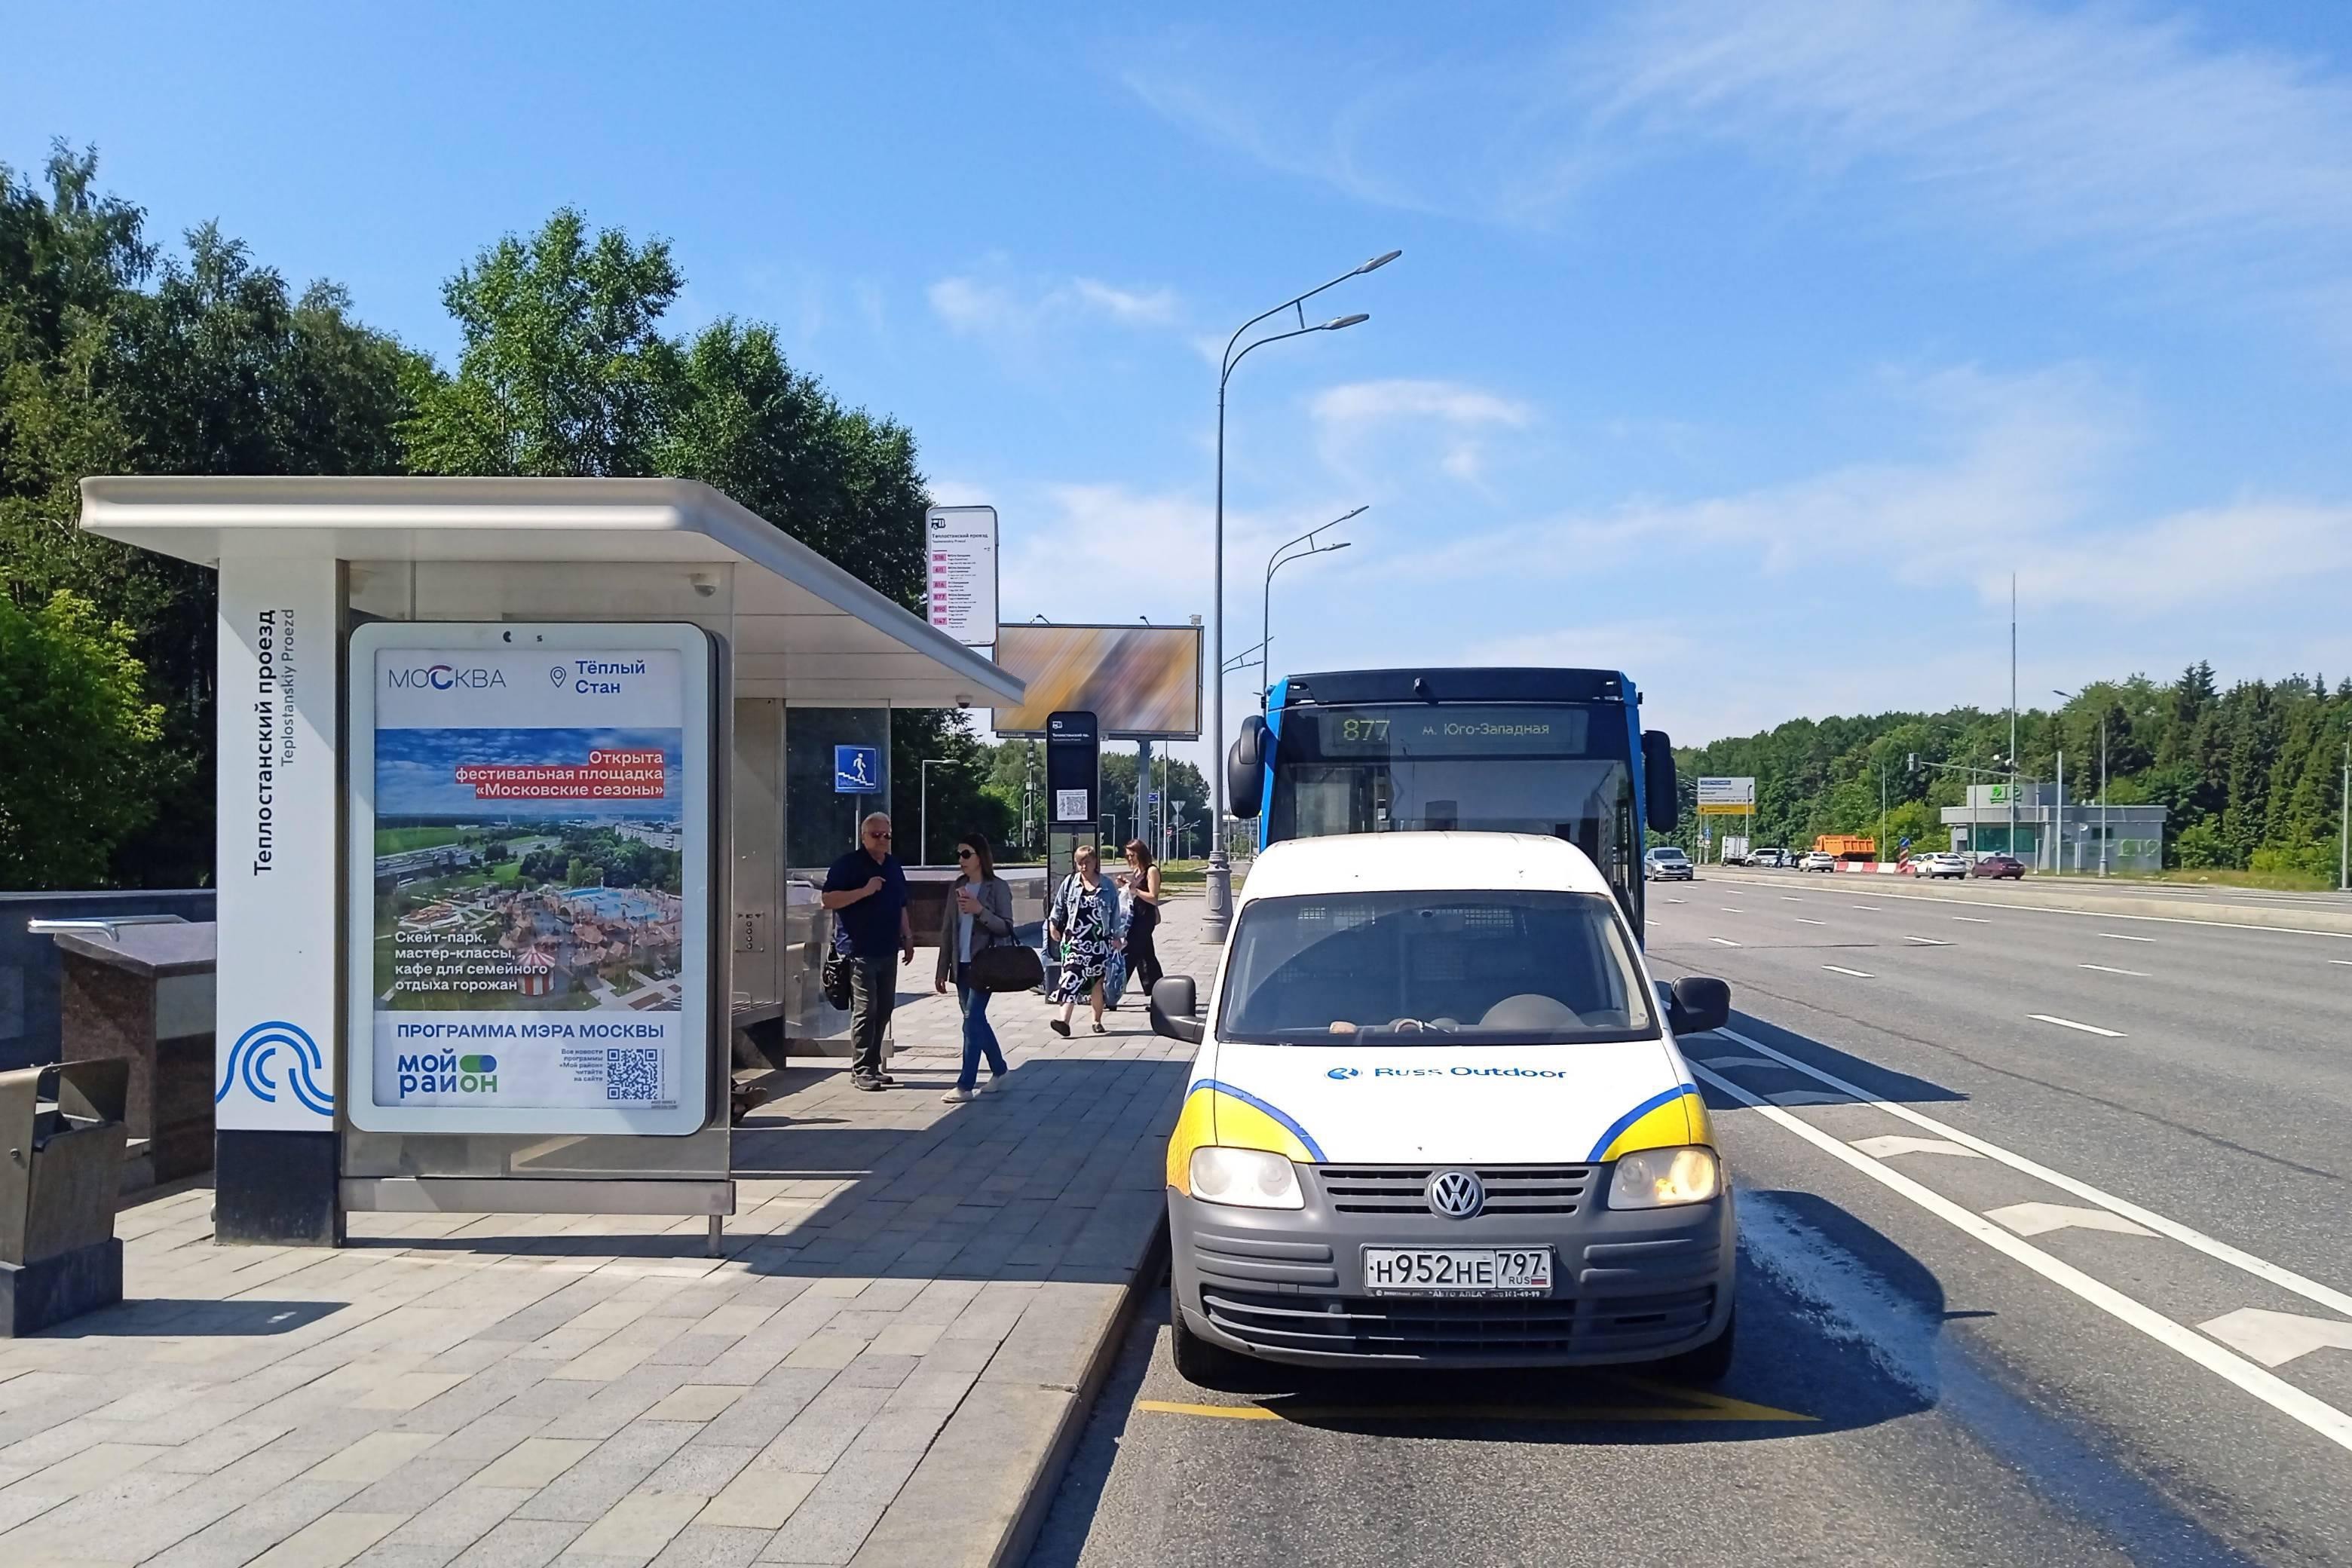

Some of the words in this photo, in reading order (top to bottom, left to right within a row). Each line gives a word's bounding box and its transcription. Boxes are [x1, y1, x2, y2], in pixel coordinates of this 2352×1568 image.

[280, 609, 294, 661] Proezd
[259, 610, 277, 693] проезд
[575, 660, 645, 675] Тёплый
[388, 664, 507, 690] МОСКВА
[575, 679, 620, 694] Стан
[280, 666, 296, 767] Teplostanskiy
[1343, 718, 1390, 741] 877
[1444, 723, 1550, 736] Юго-Западная
[589, 751, 663, 766] Открыта
[455, 767, 574, 782] фестивальная
[579, 769, 663, 781] площадка
[254, 701, 272, 876] Теплостанский
[476, 783, 589, 796] «Московские
[593, 785, 663, 796] сезоны»
[395, 931, 487, 945] Скейт-парк,
[395, 949, 516, 961] мастер-классы,
[395, 963, 433, 977] кафе
[436, 965, 463, 976] для
[467, 963, 548, 975] семейного
[395, 981, 449, 992] отдыха
[453, 981, 517, 993] горожан
[397, 1024, 518, 1038] ПРОГРАММА
[521, 1024, 575, 1038] МЭРА
[580, 1024, 665, 1038] МОСКВЫ
[1375, 1068, 1442, 1076] Russ
[1450, 1067, 1566, 1079] Outdoor
[1508, 1276, 1530, 1285] RUS
